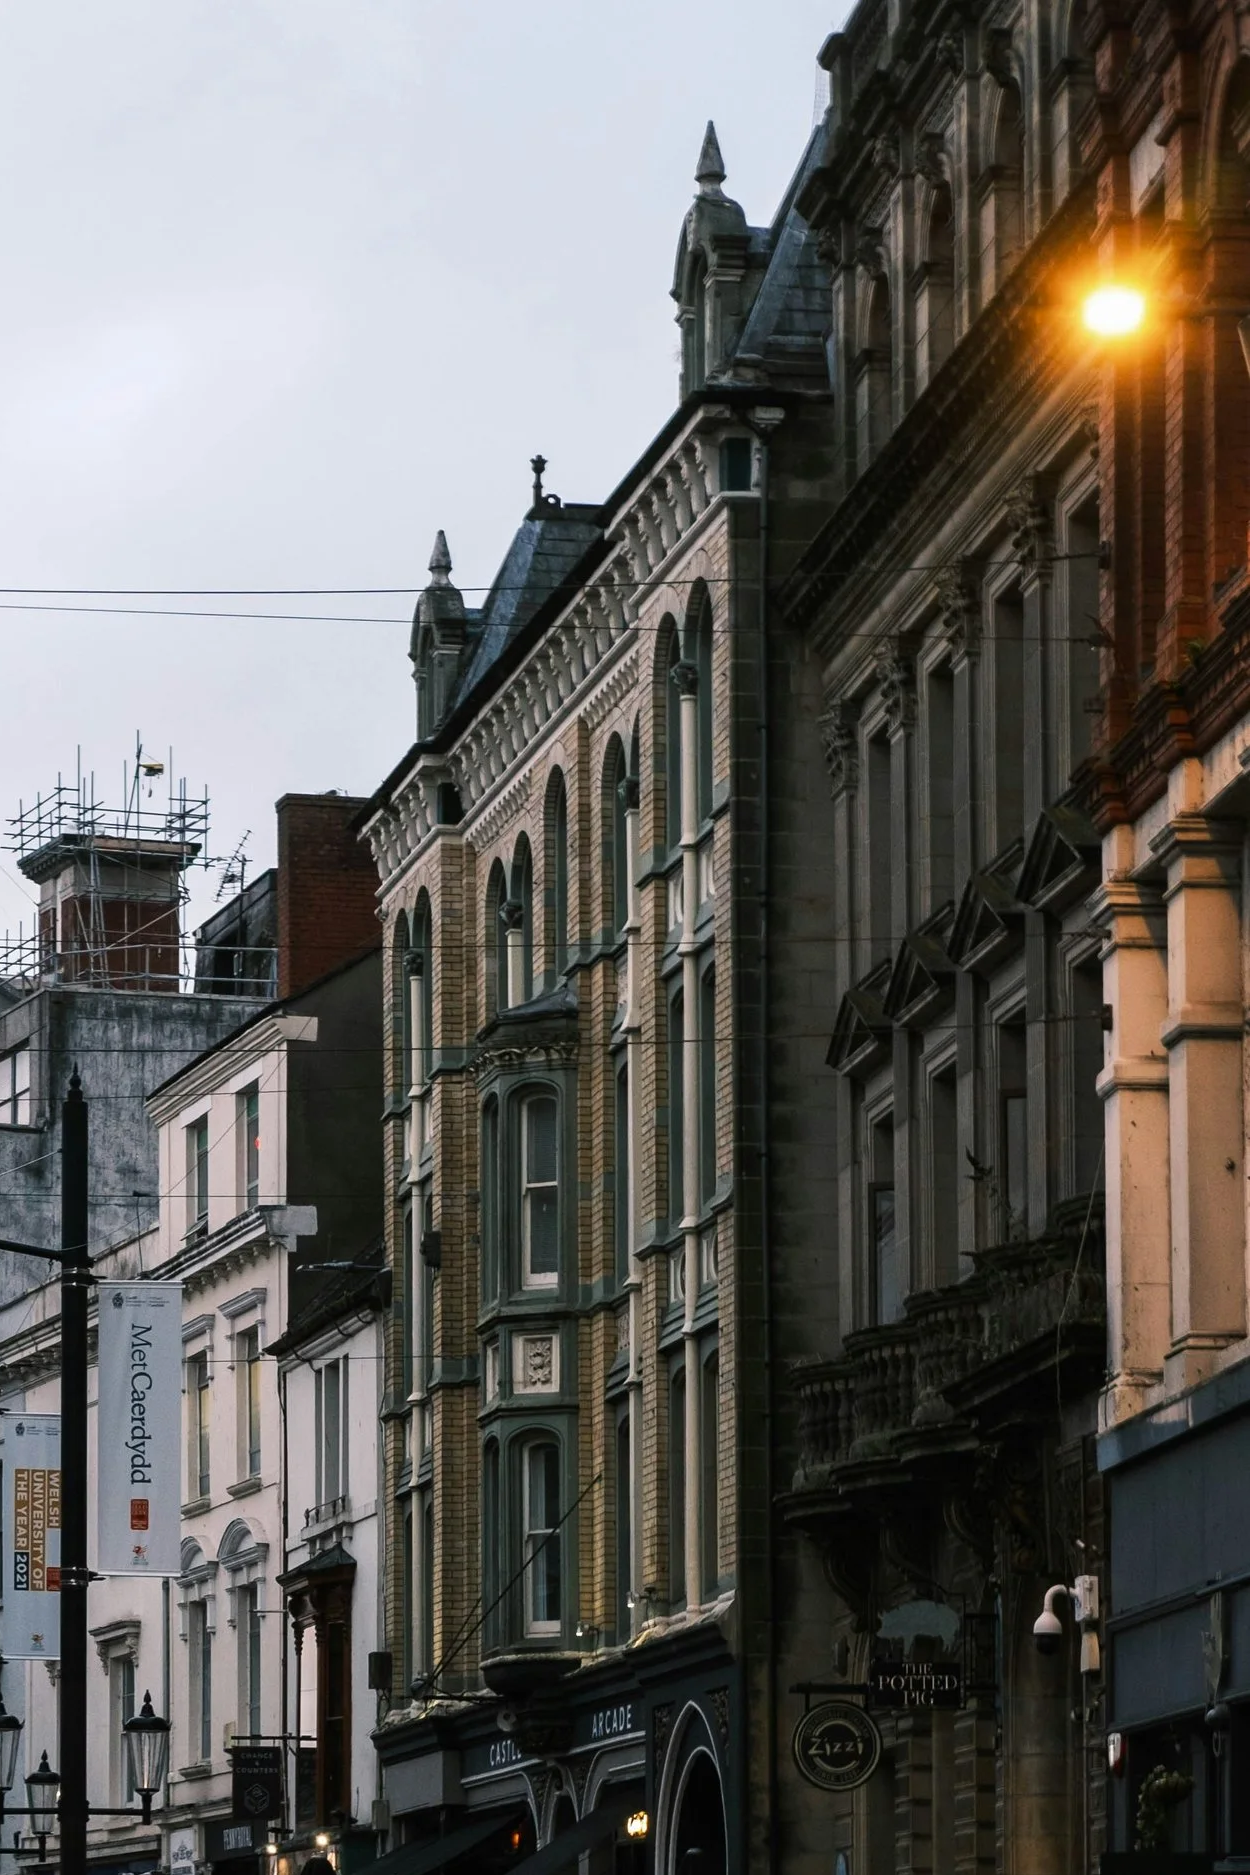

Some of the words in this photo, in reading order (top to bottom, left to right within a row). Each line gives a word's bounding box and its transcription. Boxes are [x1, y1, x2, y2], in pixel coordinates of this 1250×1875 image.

[125, 1323, 152, 1485] MetCaerdydd
[16, 1472, 27, 1501] THE
[49, 1472, 60, 1527] WELSH
[16, 1506, 27, 1547] YEAR
[33, 1471, 44, 1566] UNIVERSITY
[16, 1554, 27, 1590] 2021
[32, 1569, 44, 1590] OF
[878, 1675, 958, 1691] POTTED
[902, 1663, 933, 1675] THE
[903, 1690, 934, 1705] PIG
[591, 1703, 632, 1739] ARCADE
[808, 1736, 864, 1757] Zizzi
